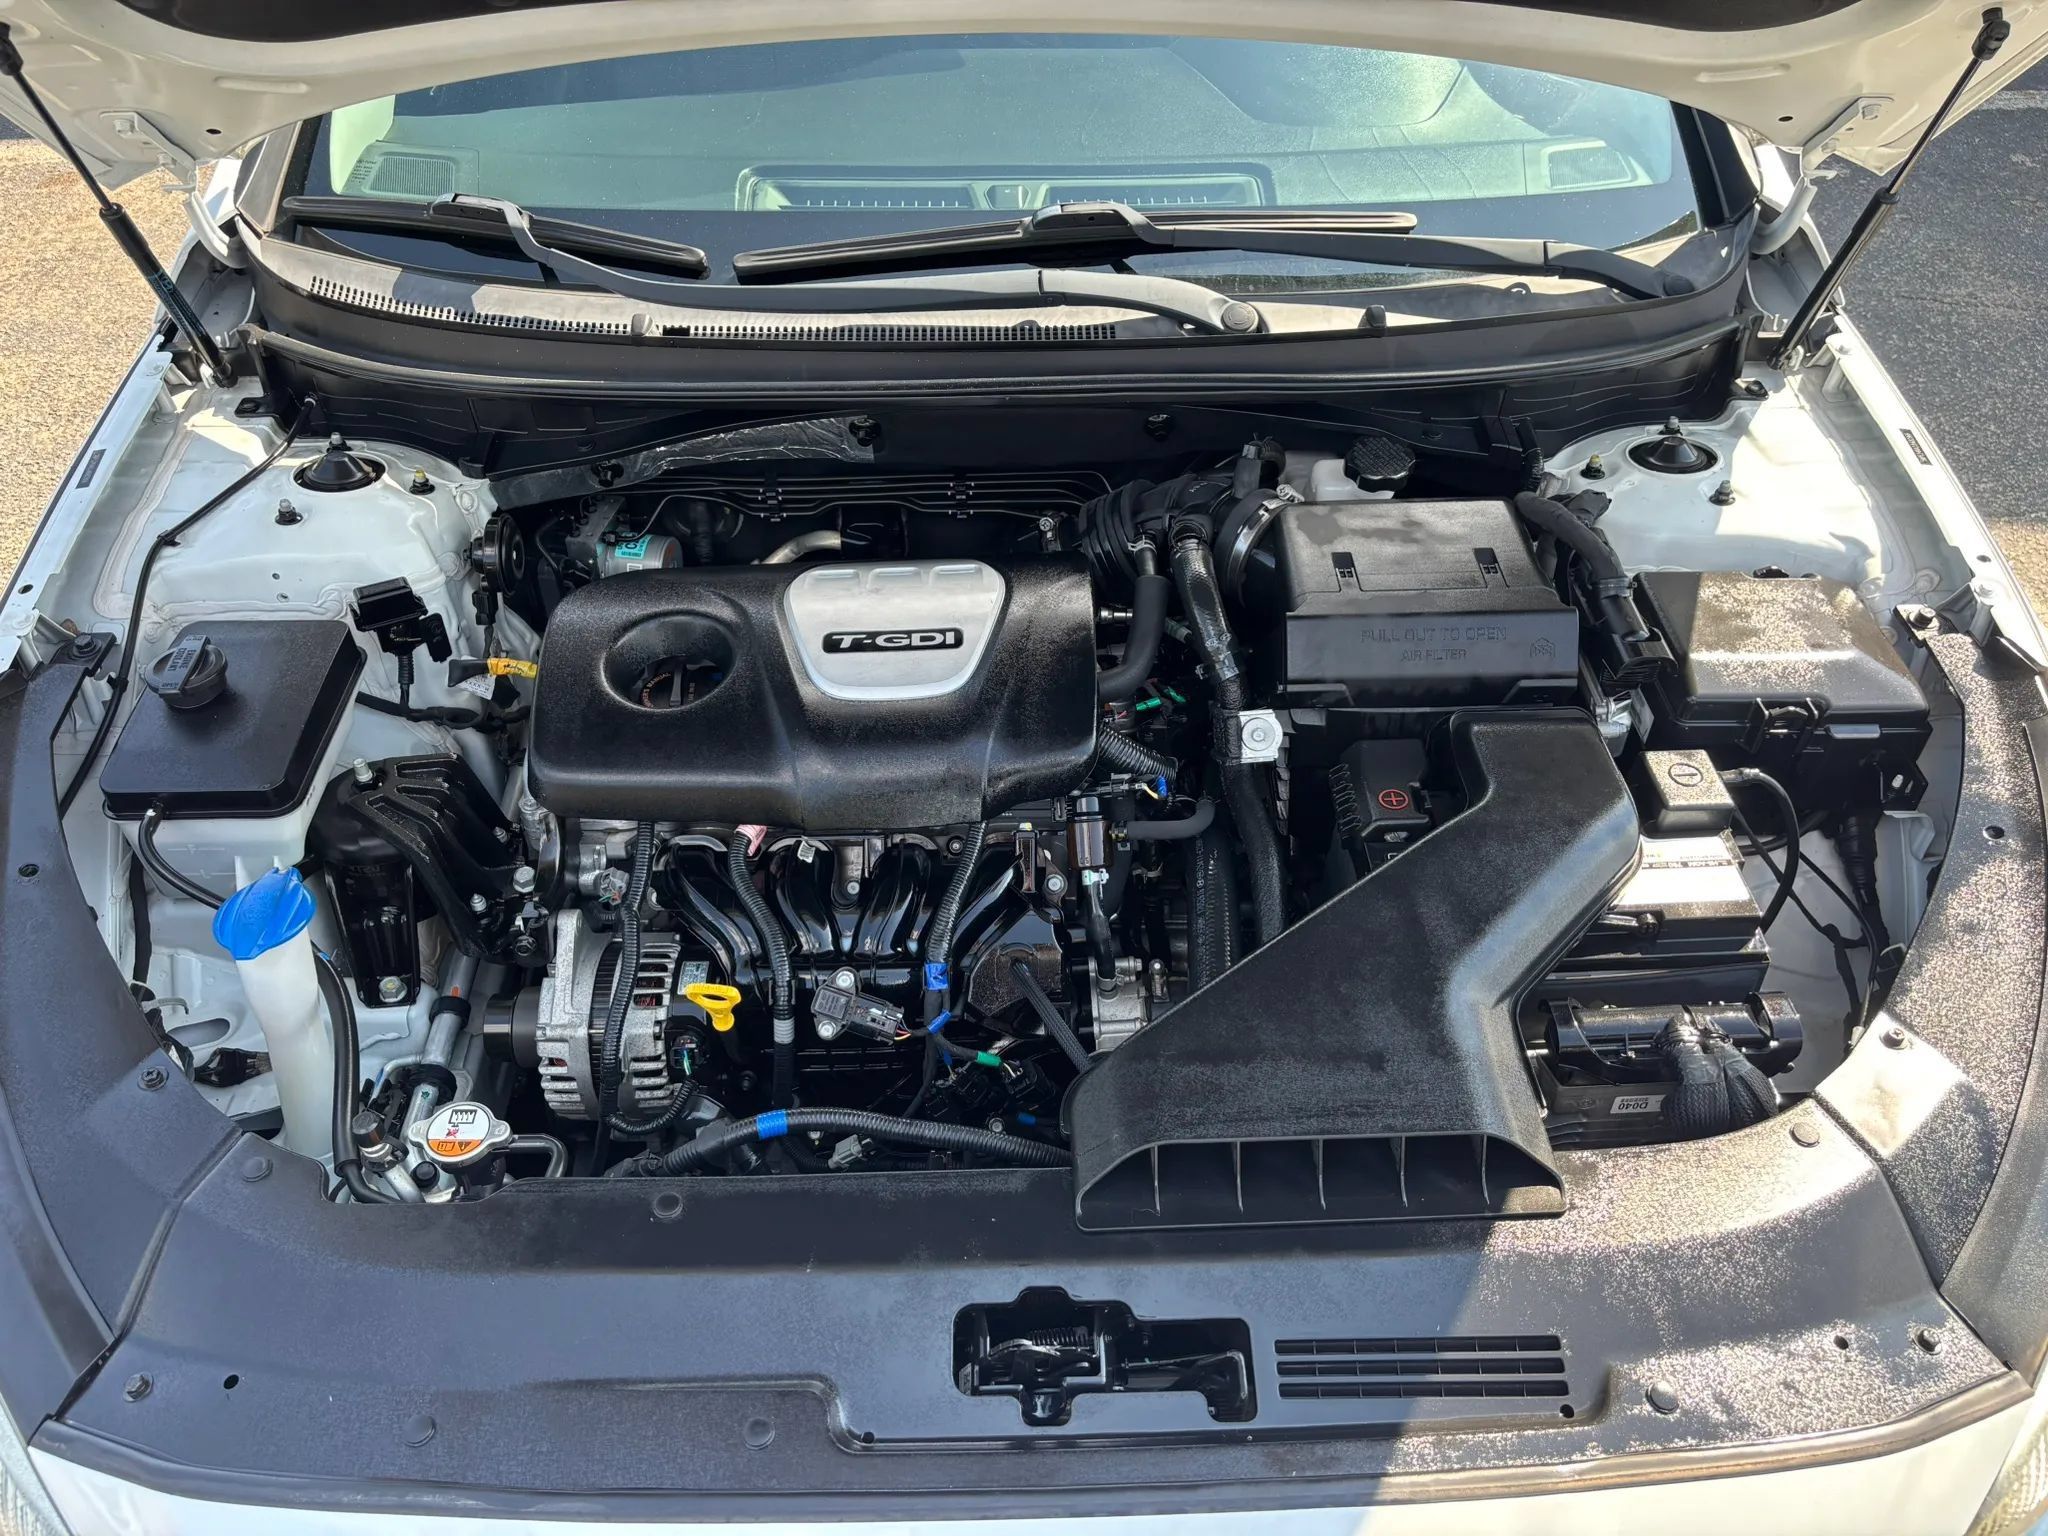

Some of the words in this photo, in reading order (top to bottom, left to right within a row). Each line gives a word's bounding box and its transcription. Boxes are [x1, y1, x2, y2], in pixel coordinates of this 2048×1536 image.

[831, 631, 955, 649] T-GDI
[1361, 628, 1401, 643] PULL
[1404, 626, 1436, 641] OUT
[1440, 626, 1460, 641] TO
[1465, 625, 1507, 641] OPEN
[1400, 648, 1422, 662] AIR
[1425, 647, 1467, 662] FILTER
